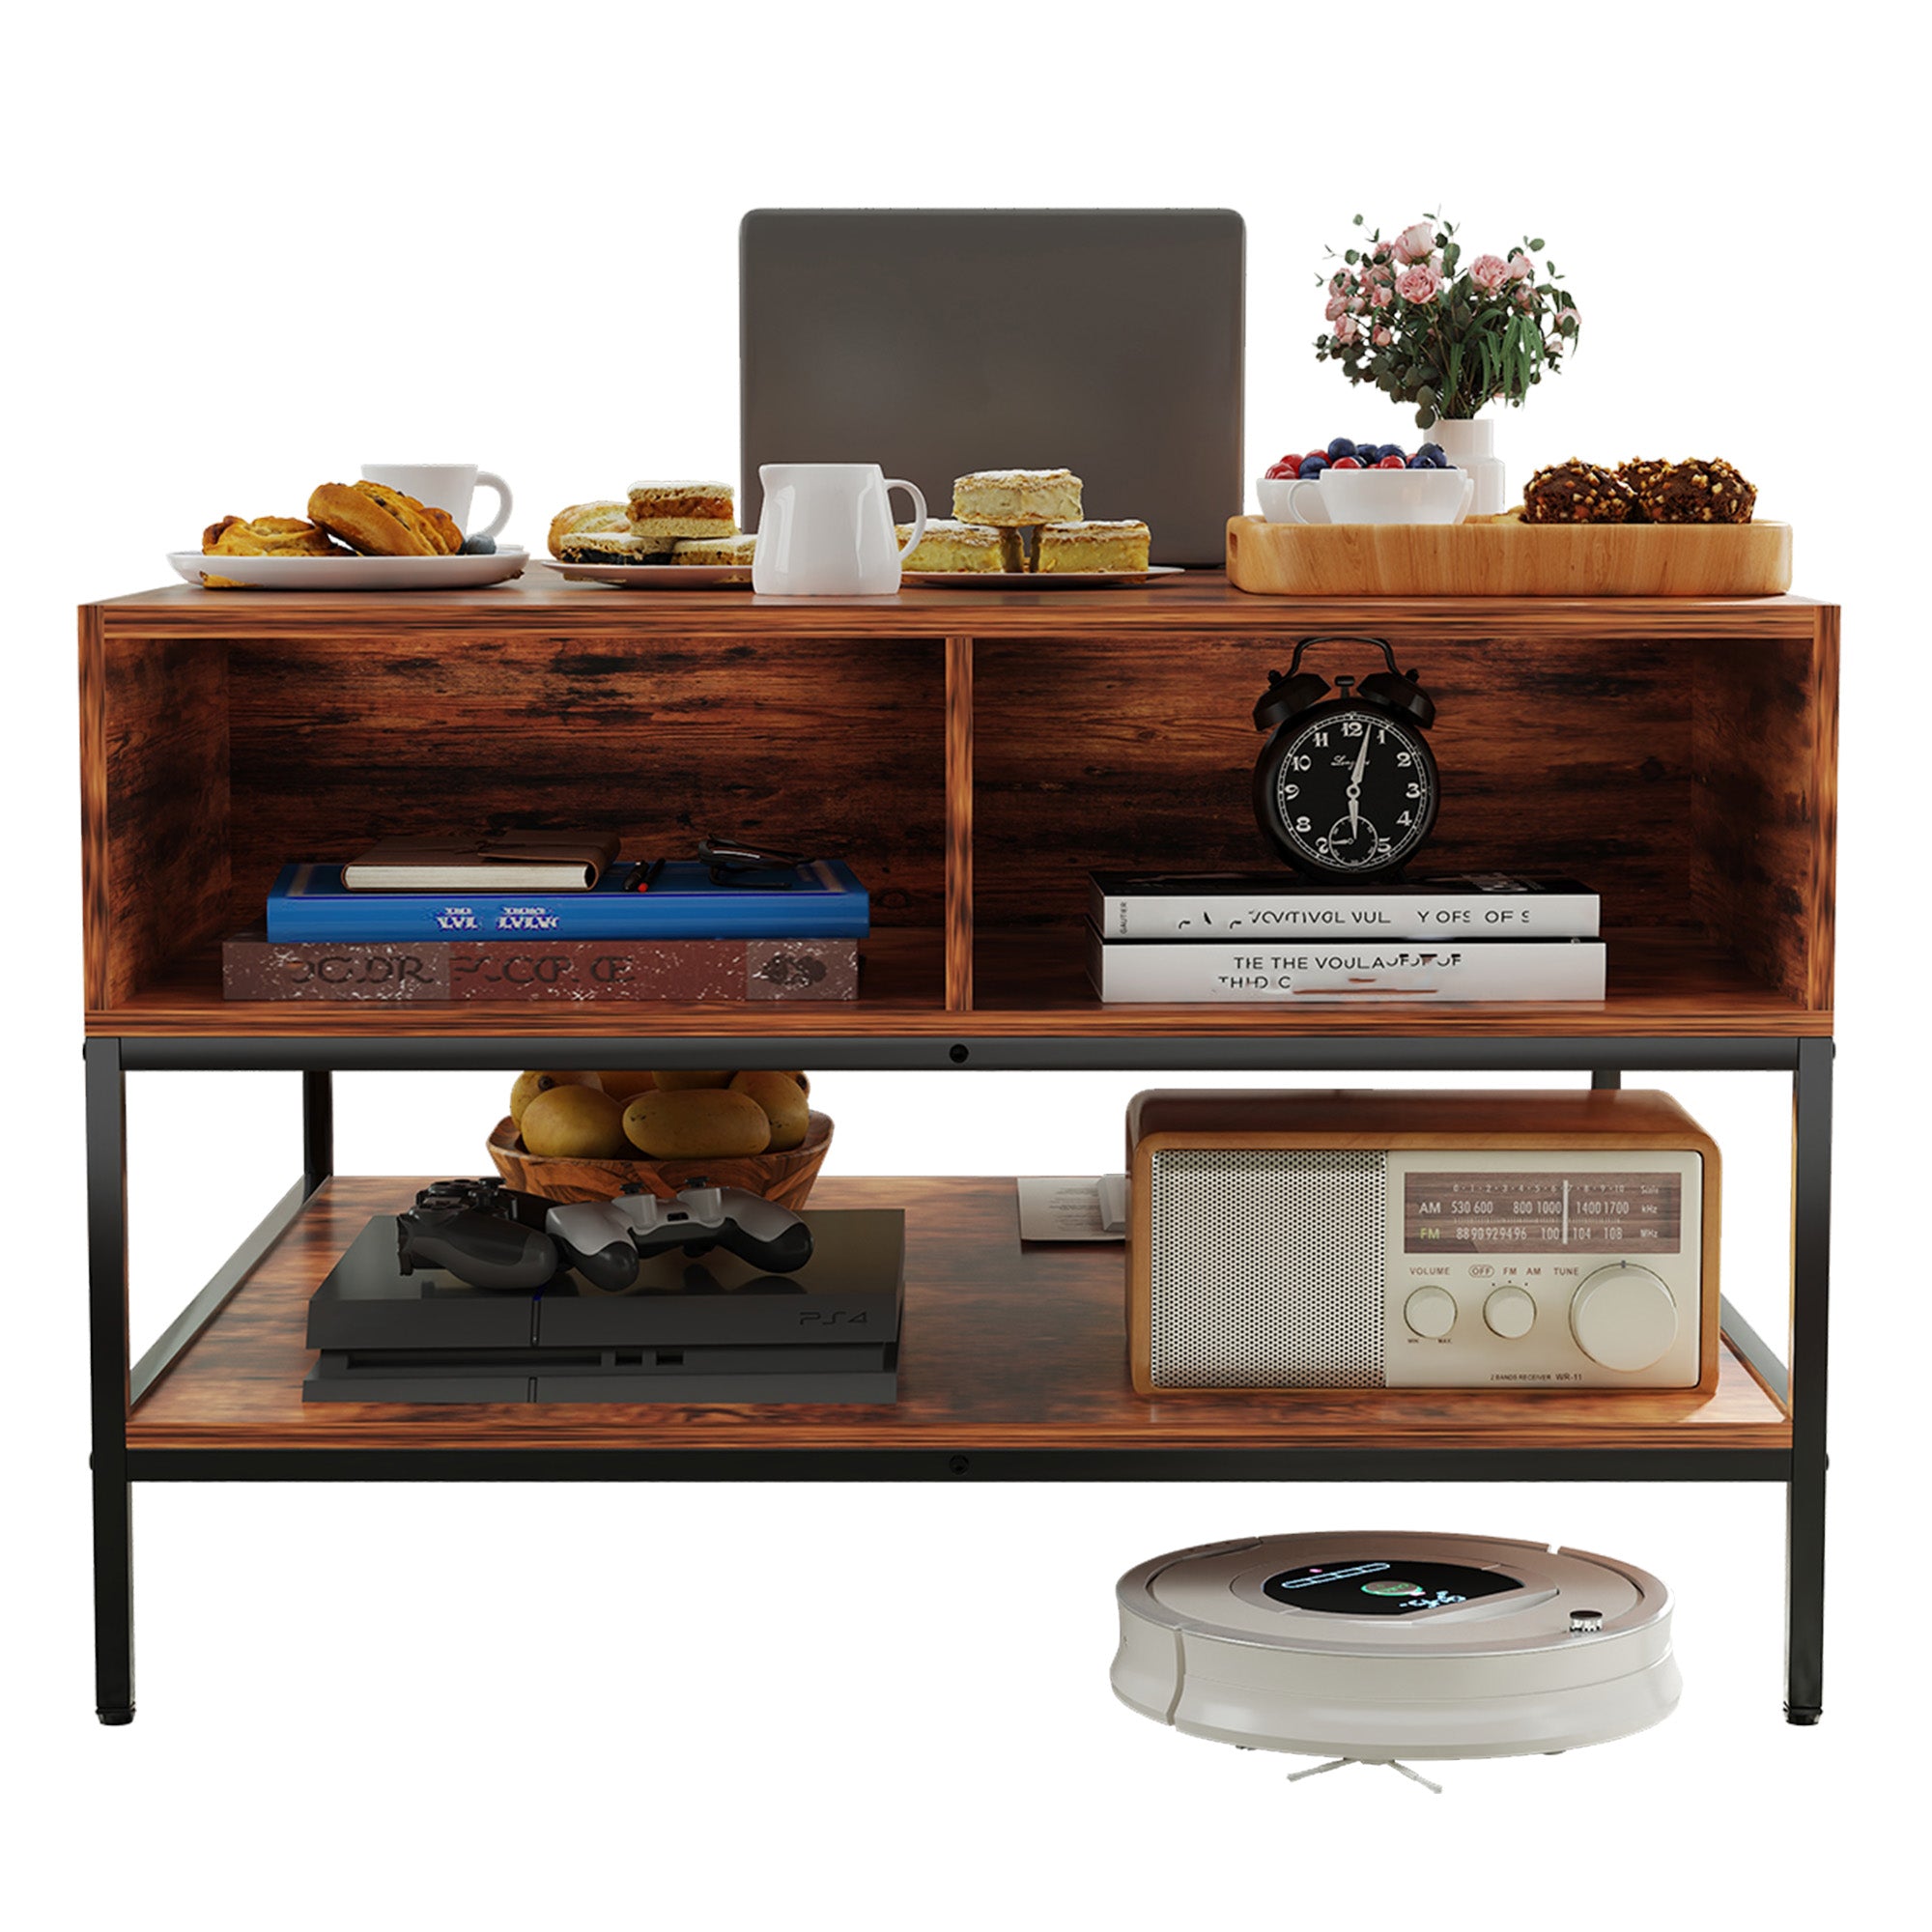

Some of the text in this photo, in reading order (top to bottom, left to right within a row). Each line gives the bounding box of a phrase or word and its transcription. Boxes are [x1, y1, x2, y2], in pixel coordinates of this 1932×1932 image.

[1341, 723, 1363, 737] 12
[1377, 729, 1385, 745] 1
[1313, 732, 1329, 747] 11
[1292, 754, 1311, 771] 10
[1397, 752, 1411, 767] 2
[1284, 783, 1299, 800] 9
[1406, 782, 1421, 798] 3
[1295, 816, 1311, 833] 8
[1396, 810, 1412, 826] 4
[1378, 837, 1391, 853] 5
[1485, 910, 1514, 923] OF
[1271, 956, 1308, 969] THE
[1419, 1201, 1658, 1214] AM 530 600 800 1000 1400 1700 kHz
[1420, 1227, 1440, 1240] FM
[1514, 1227, 1527, 1240] 96
[1541, 1227, 1560, 1240] 100
[1573, 1227, 1592, 1240] 104
[1604, 1227, 1623, 1240] 108
[1409, 1266, 1450, 1276] VOLUME
[1471, 1266, 1542, 1276] OFF FM AM
[1553, 1266, 1579, 1276] TUNE
[799, 1311, 867, 1325] PS4
[1555, 1373, 1582, 1381] WR-11
